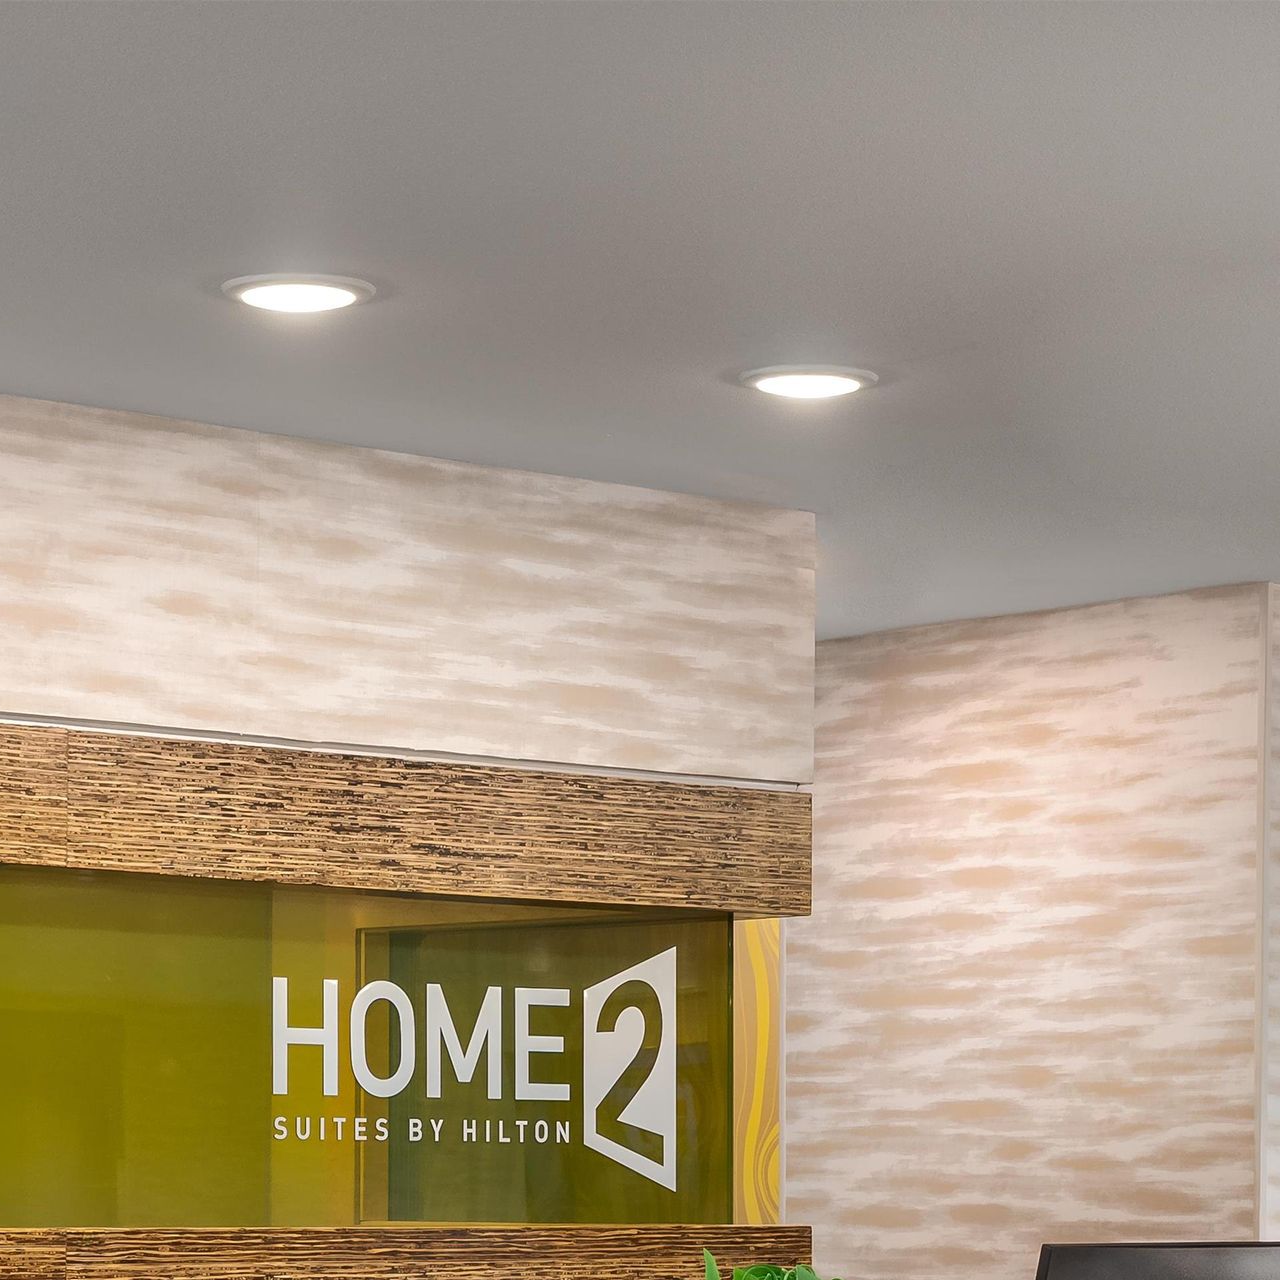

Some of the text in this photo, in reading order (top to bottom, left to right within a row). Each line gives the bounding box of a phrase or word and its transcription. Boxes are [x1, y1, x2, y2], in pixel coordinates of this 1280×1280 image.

[273, 1116, 571, 1144] SUITES BY HILTON
